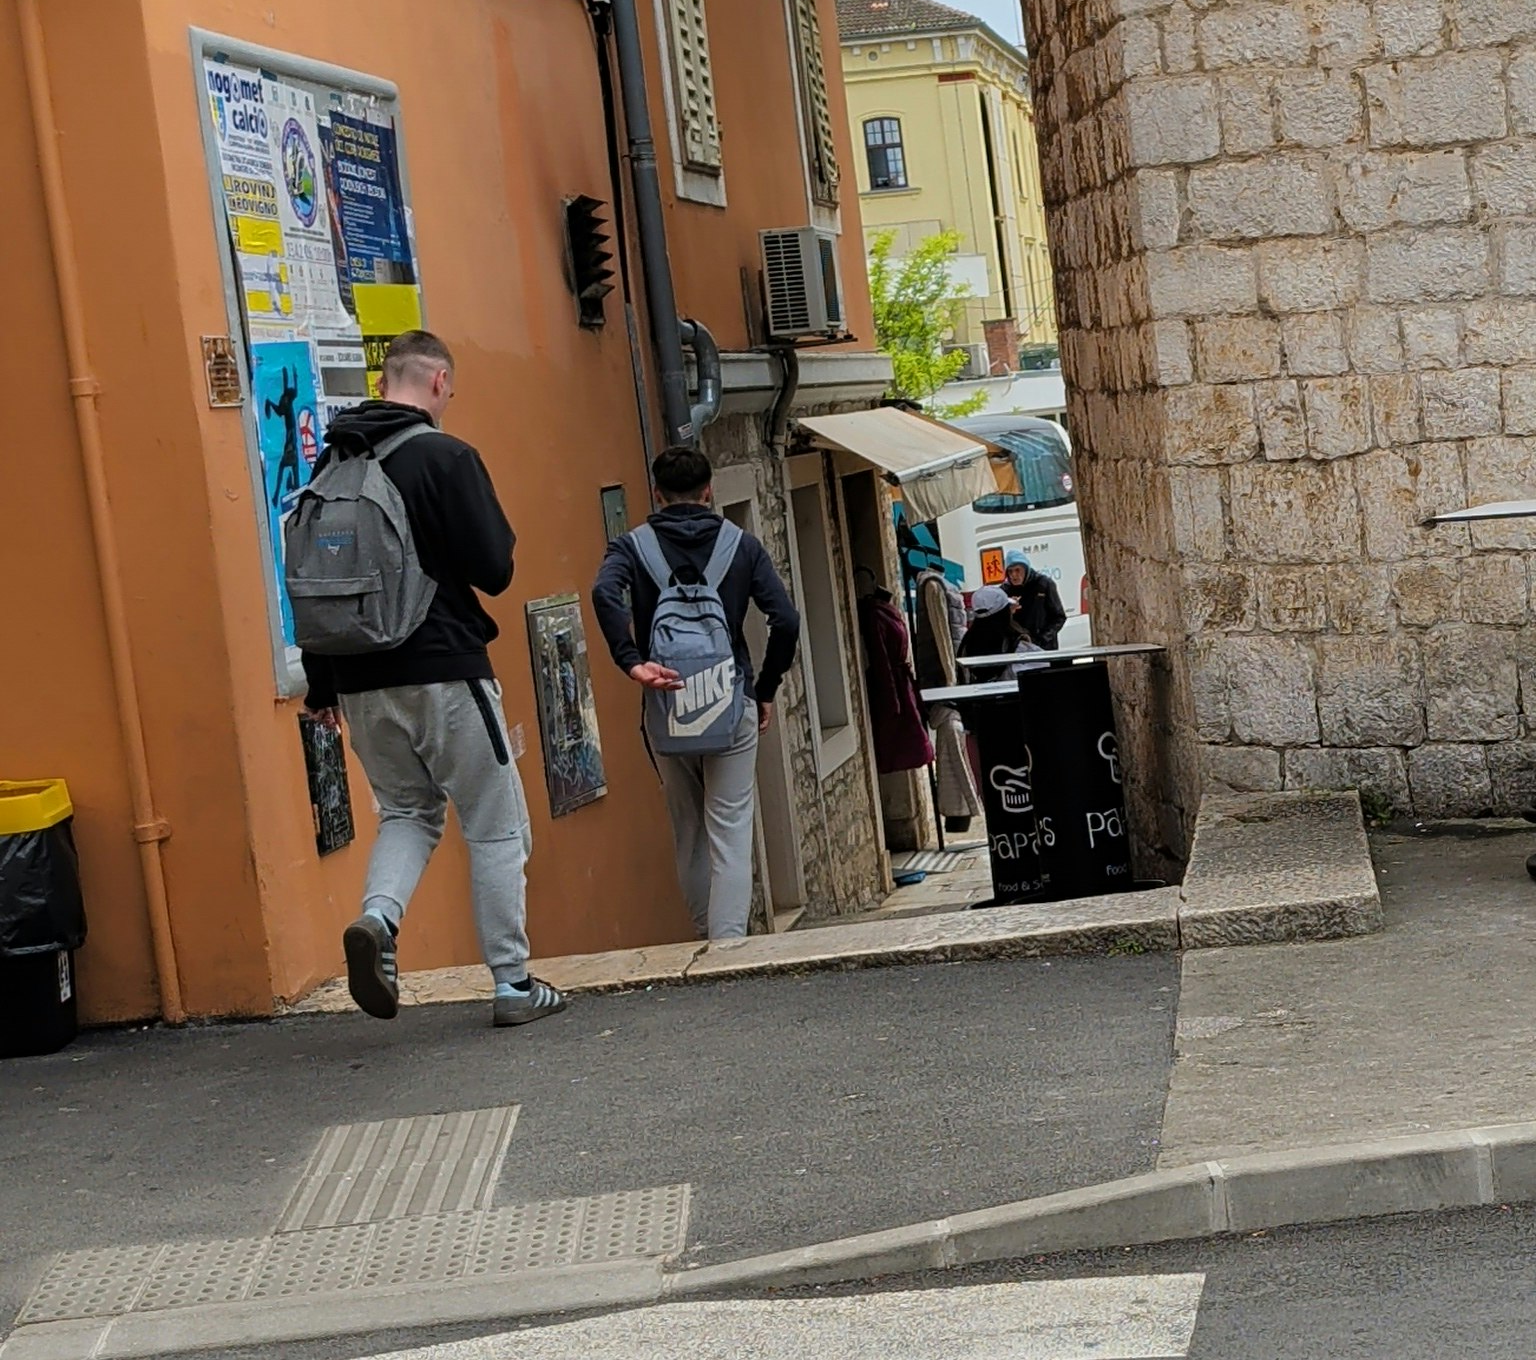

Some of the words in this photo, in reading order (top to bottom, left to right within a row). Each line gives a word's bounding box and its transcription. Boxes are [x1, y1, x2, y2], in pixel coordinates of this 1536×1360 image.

[207, 70, 264, 104] nogomet
[232, 104, 268, 139] calcio
[233, 179, 277, 199] ROVINJ
[673, 657, 735, 718] NIKE
